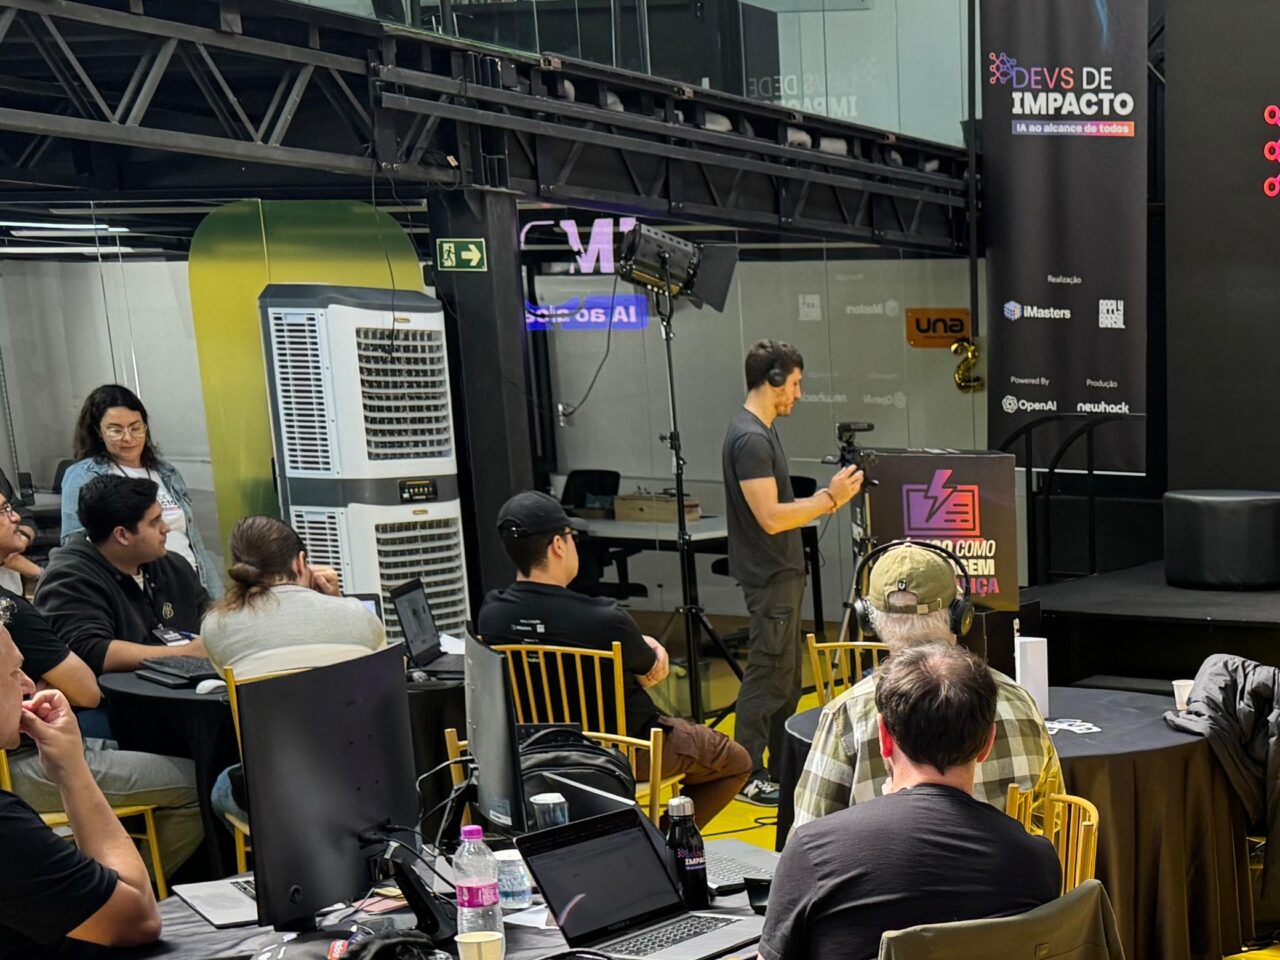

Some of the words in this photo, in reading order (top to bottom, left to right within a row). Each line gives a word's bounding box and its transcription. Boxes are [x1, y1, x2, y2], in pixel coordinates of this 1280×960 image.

[1012, 67, 1075, 90] DEVS
[1082, 67, 1113, 90] DE
[1012, 92, 1135, 116] IMPACTO
[1016, 123, 1027, 132] IA
[1029, 124, 1042, 133] ao
[1043, 123, 1082, 133] alcance
[1084, 123, 1098, 133] de
[1100, 123, 1130, 133] todos
[1047, 275, 1082, 285] Realização
[1023, 305, 1071, 319] iMasters
[915, 317, 964, 334] una
[1040, 377, 1050, 386] By
[1086, 379, 1118, 388] Produção
[1018, 399, 1057, 412] OpenAI
[955, 540, 996, 557] COMO
